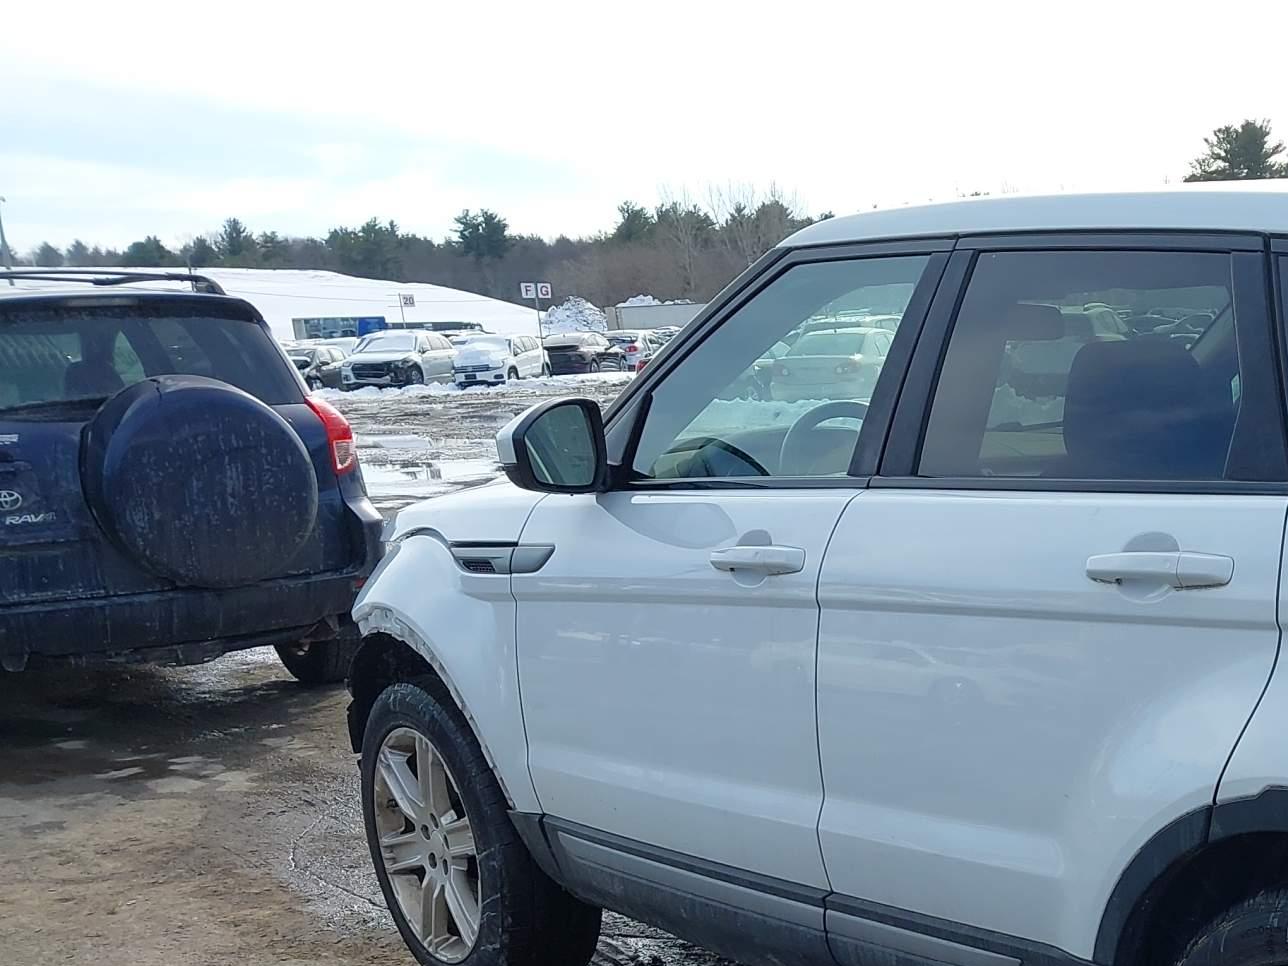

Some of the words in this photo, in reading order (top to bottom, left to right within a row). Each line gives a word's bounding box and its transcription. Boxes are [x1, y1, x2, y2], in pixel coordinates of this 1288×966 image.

[525, 286, 533, 296] F
[539, 285, 550, 297] G
[403, 296, 415, 306] 20
